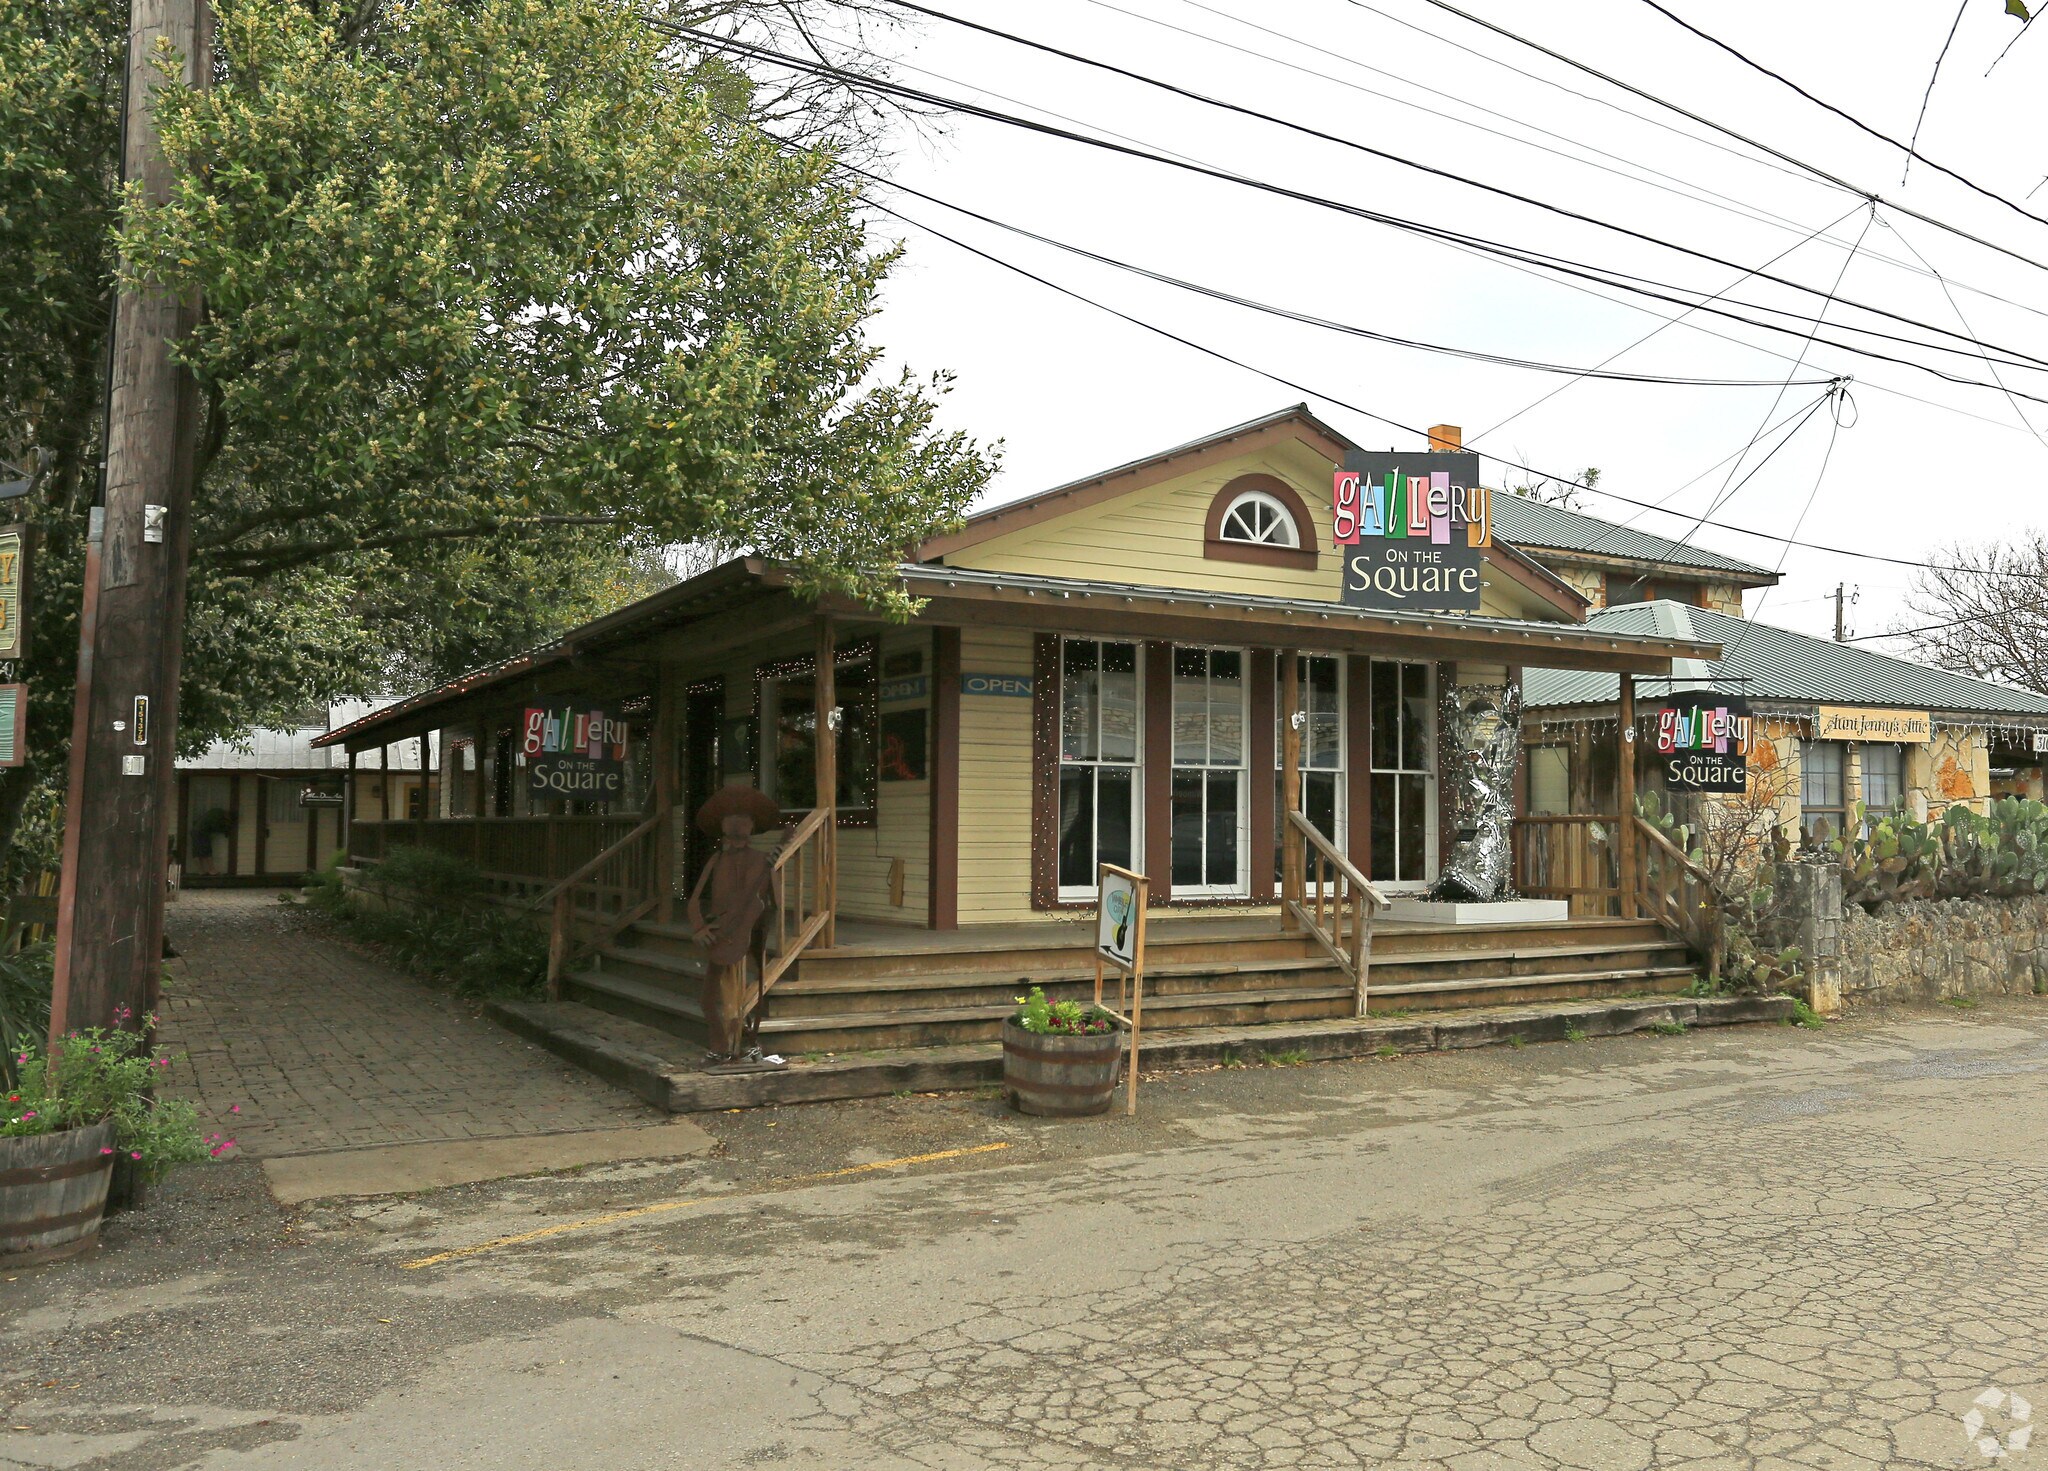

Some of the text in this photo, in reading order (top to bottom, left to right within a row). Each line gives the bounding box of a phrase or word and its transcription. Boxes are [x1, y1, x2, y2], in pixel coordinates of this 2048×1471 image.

[1386, 549, 1442, 563] ON THE
[880, 681, 920, 698] OPEN
[967, 678, 1034, 693] OPEN
[1825, 714, 1927, 737] Aunt Jenny's Attic
[558, 760, 595, 770] ON THE
[1690, 755, 1723, 765] ON THE
